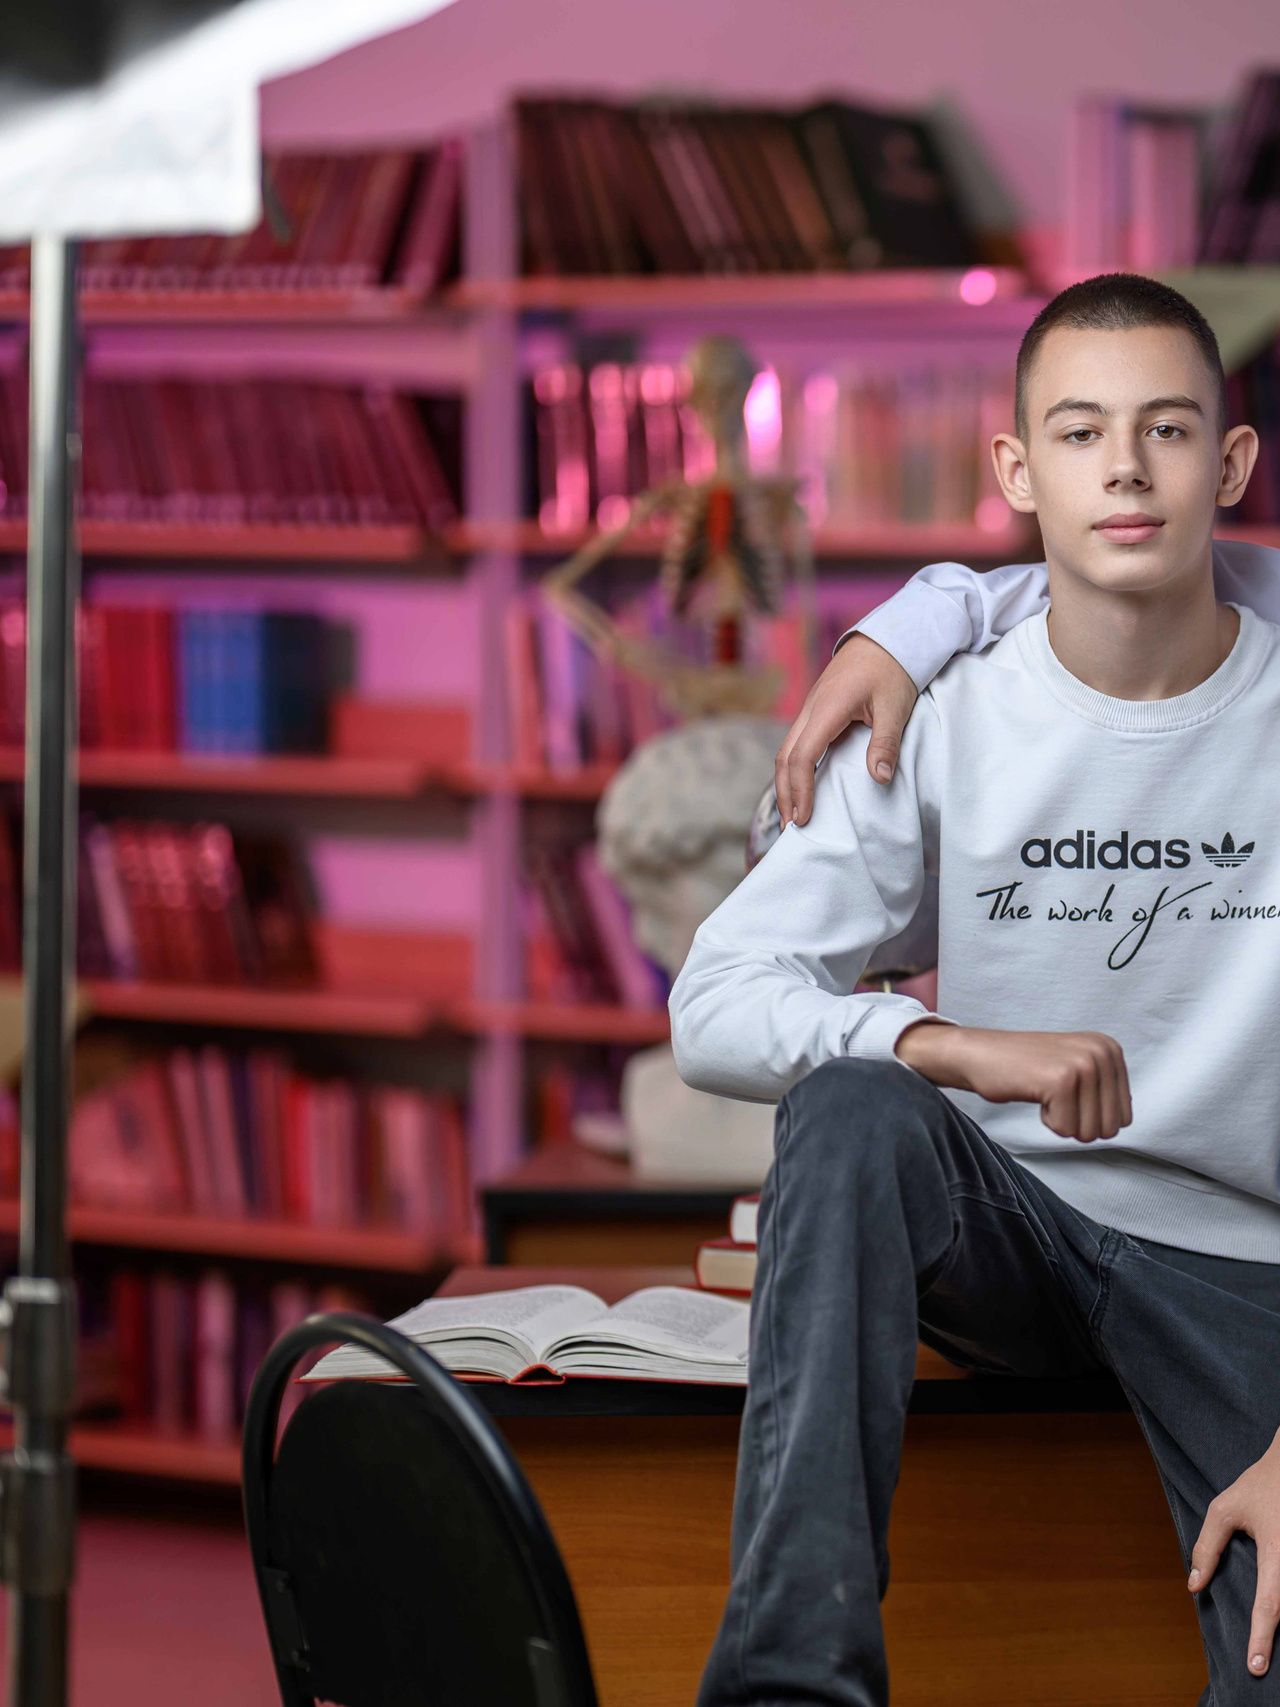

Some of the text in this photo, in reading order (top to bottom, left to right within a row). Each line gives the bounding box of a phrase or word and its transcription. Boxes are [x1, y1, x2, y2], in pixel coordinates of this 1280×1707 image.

[1020, 829, 1191, 870] adidas
[976, 881, 1032, 921] The
[1048, 883, 1114, 923] work
[1107, 881, 1213, 971] of
[1177, 906, 1194, 921] a
